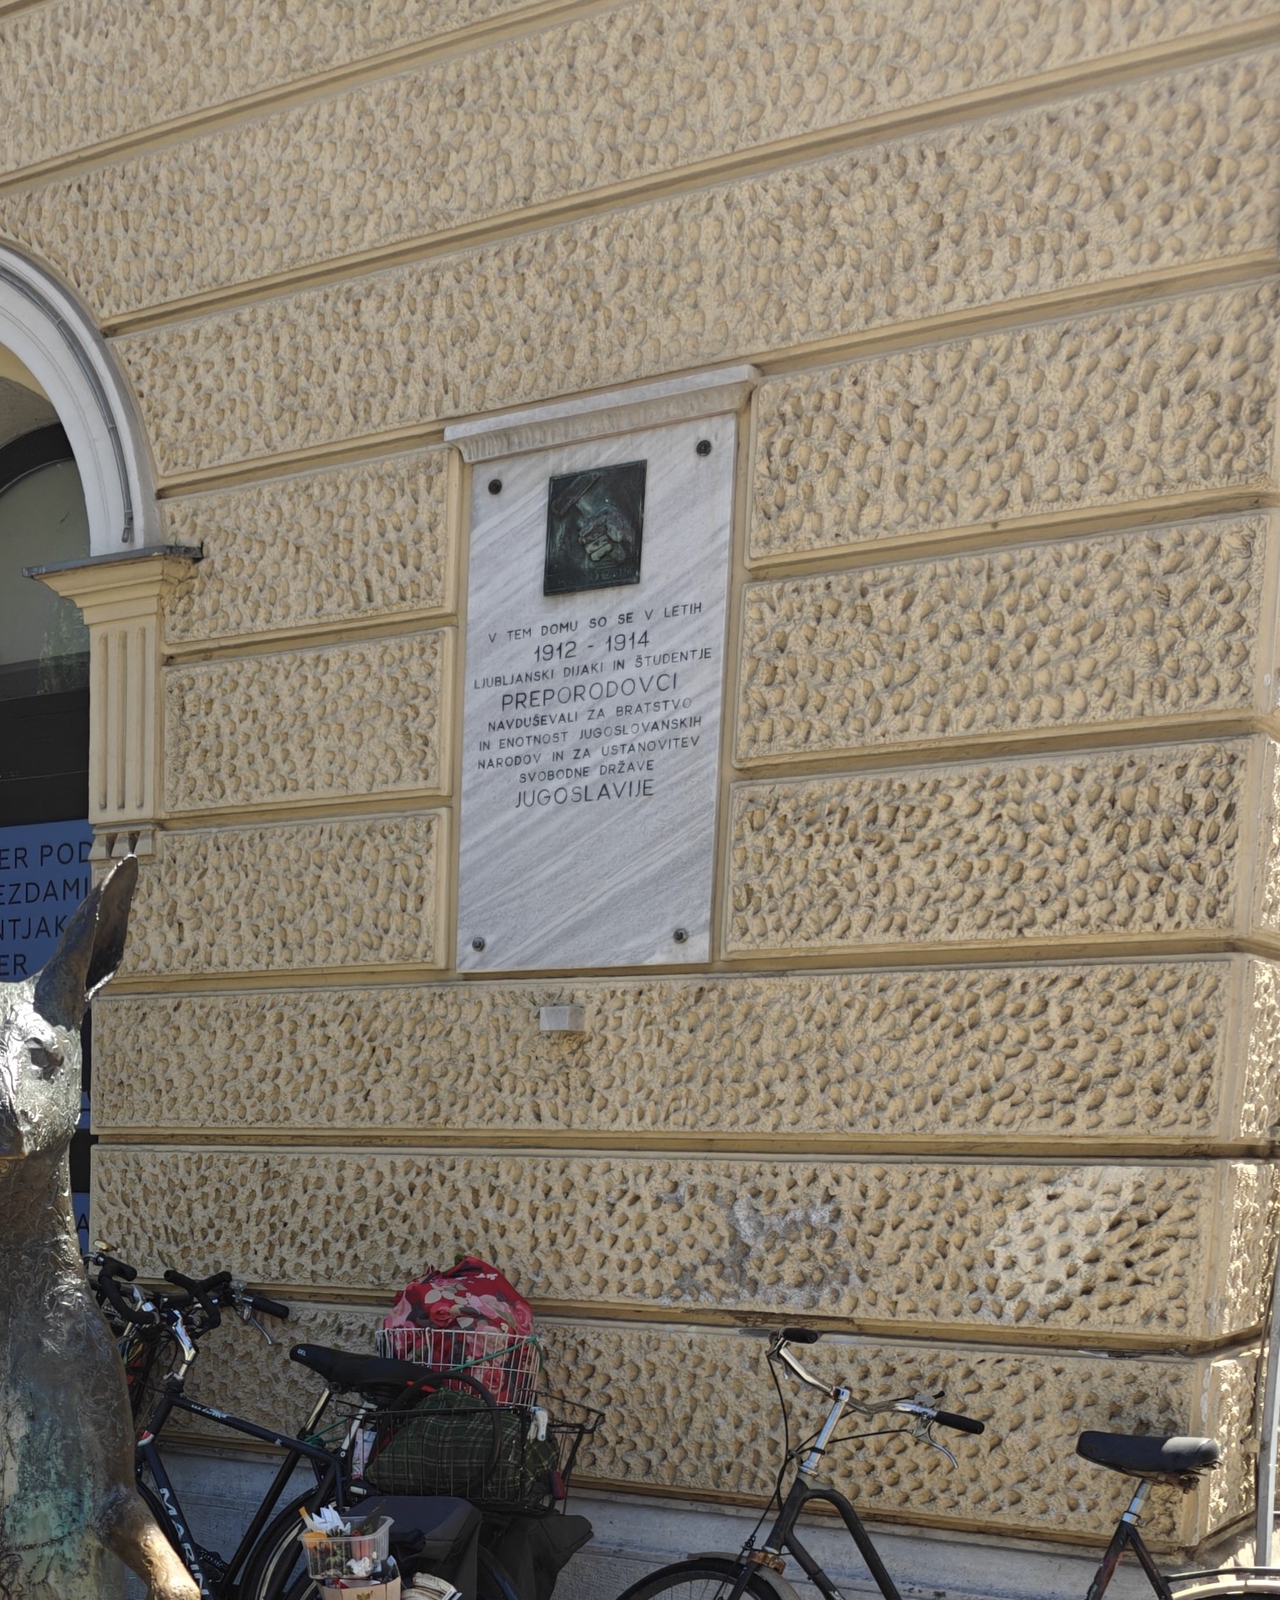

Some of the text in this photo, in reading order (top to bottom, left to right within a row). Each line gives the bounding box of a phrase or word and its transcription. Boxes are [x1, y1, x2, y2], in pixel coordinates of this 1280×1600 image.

[488, 602, 702, 643] V TEM DOMU SO SE V LETIH
[534, 641, 576, 663] 1912
[605, 630, 650, 652] 1914
[474, 648, 712, 690] LJUBLJANSKI DIJAKI IN ŠTUDENTJE
[502, 672, 677, 712] PREPORODOVCI
[488, 697, 692, 732] NAVDUŠEVALI ZA BRATSTVO
[479, 716, 702, 752] IN ENOTNOST JUGOSLOVANSKIH
[477, 735, 700, 770] NARODOV IN ZA USTANOVITEV
[519, 759, 655, 783] SVOBODNE DRŽAVE
[515, 779, 654, 808] JUGOSLAVIJE
[40, 841, 92, 867] POD
